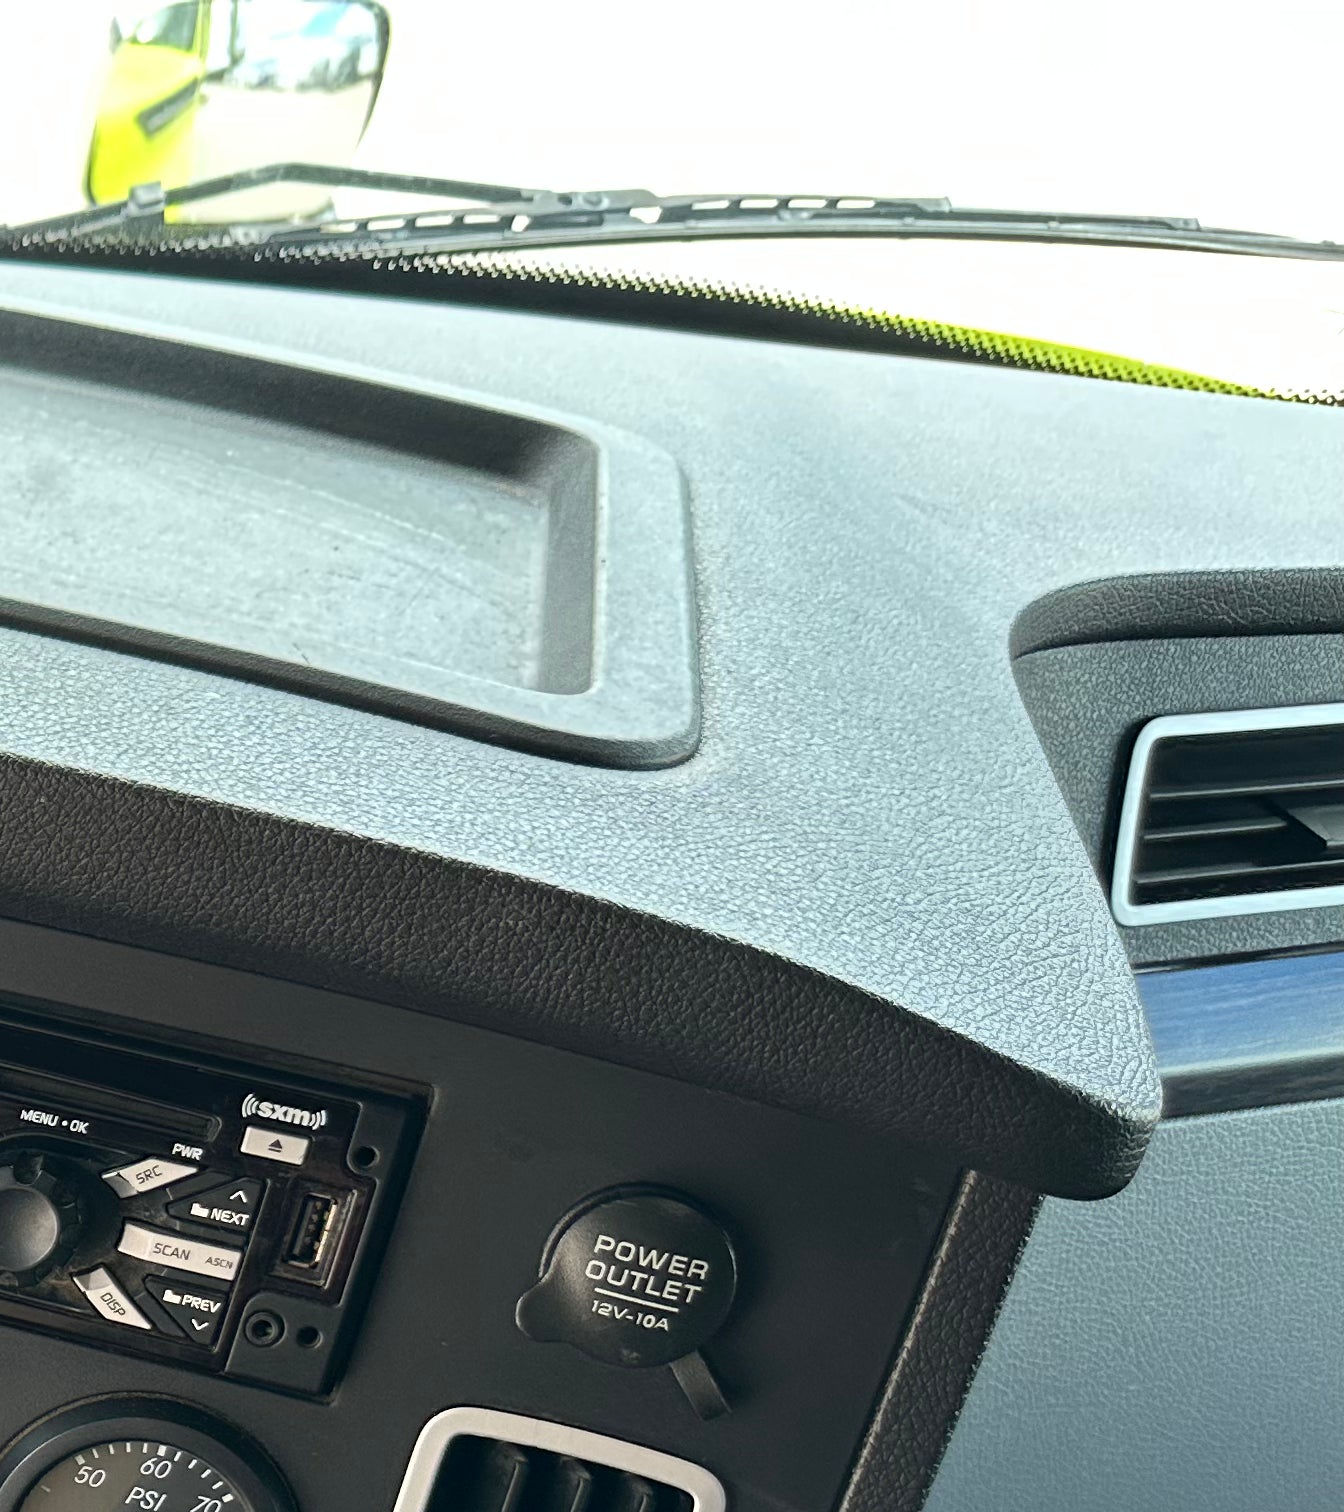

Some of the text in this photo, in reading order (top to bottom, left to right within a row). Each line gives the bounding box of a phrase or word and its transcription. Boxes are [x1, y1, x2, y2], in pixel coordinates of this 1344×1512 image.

[20, 1109, 90, 1134] MENU OK
[172, 1142, 203, 1161] PWR
[135, 1164, 163, 1185] SRC
[210, 1208, 250, 1226] NEXT
[153, 1242, 233, 1269] SCAN ASCN
[594, 1234, 709, 1281] POWER
[585, 1260, 703, 1304] OUTLET
[100, 1292, 126, 1316] DISP
[181, 1294, 221, 1313] PREV
[591, 1299, 670, 1333] 12V-10A
[74, 1466, 106, 1488] 50
[139, 1457, 172, 1479] 60
[124, 1486, 167, 1512] PSI
